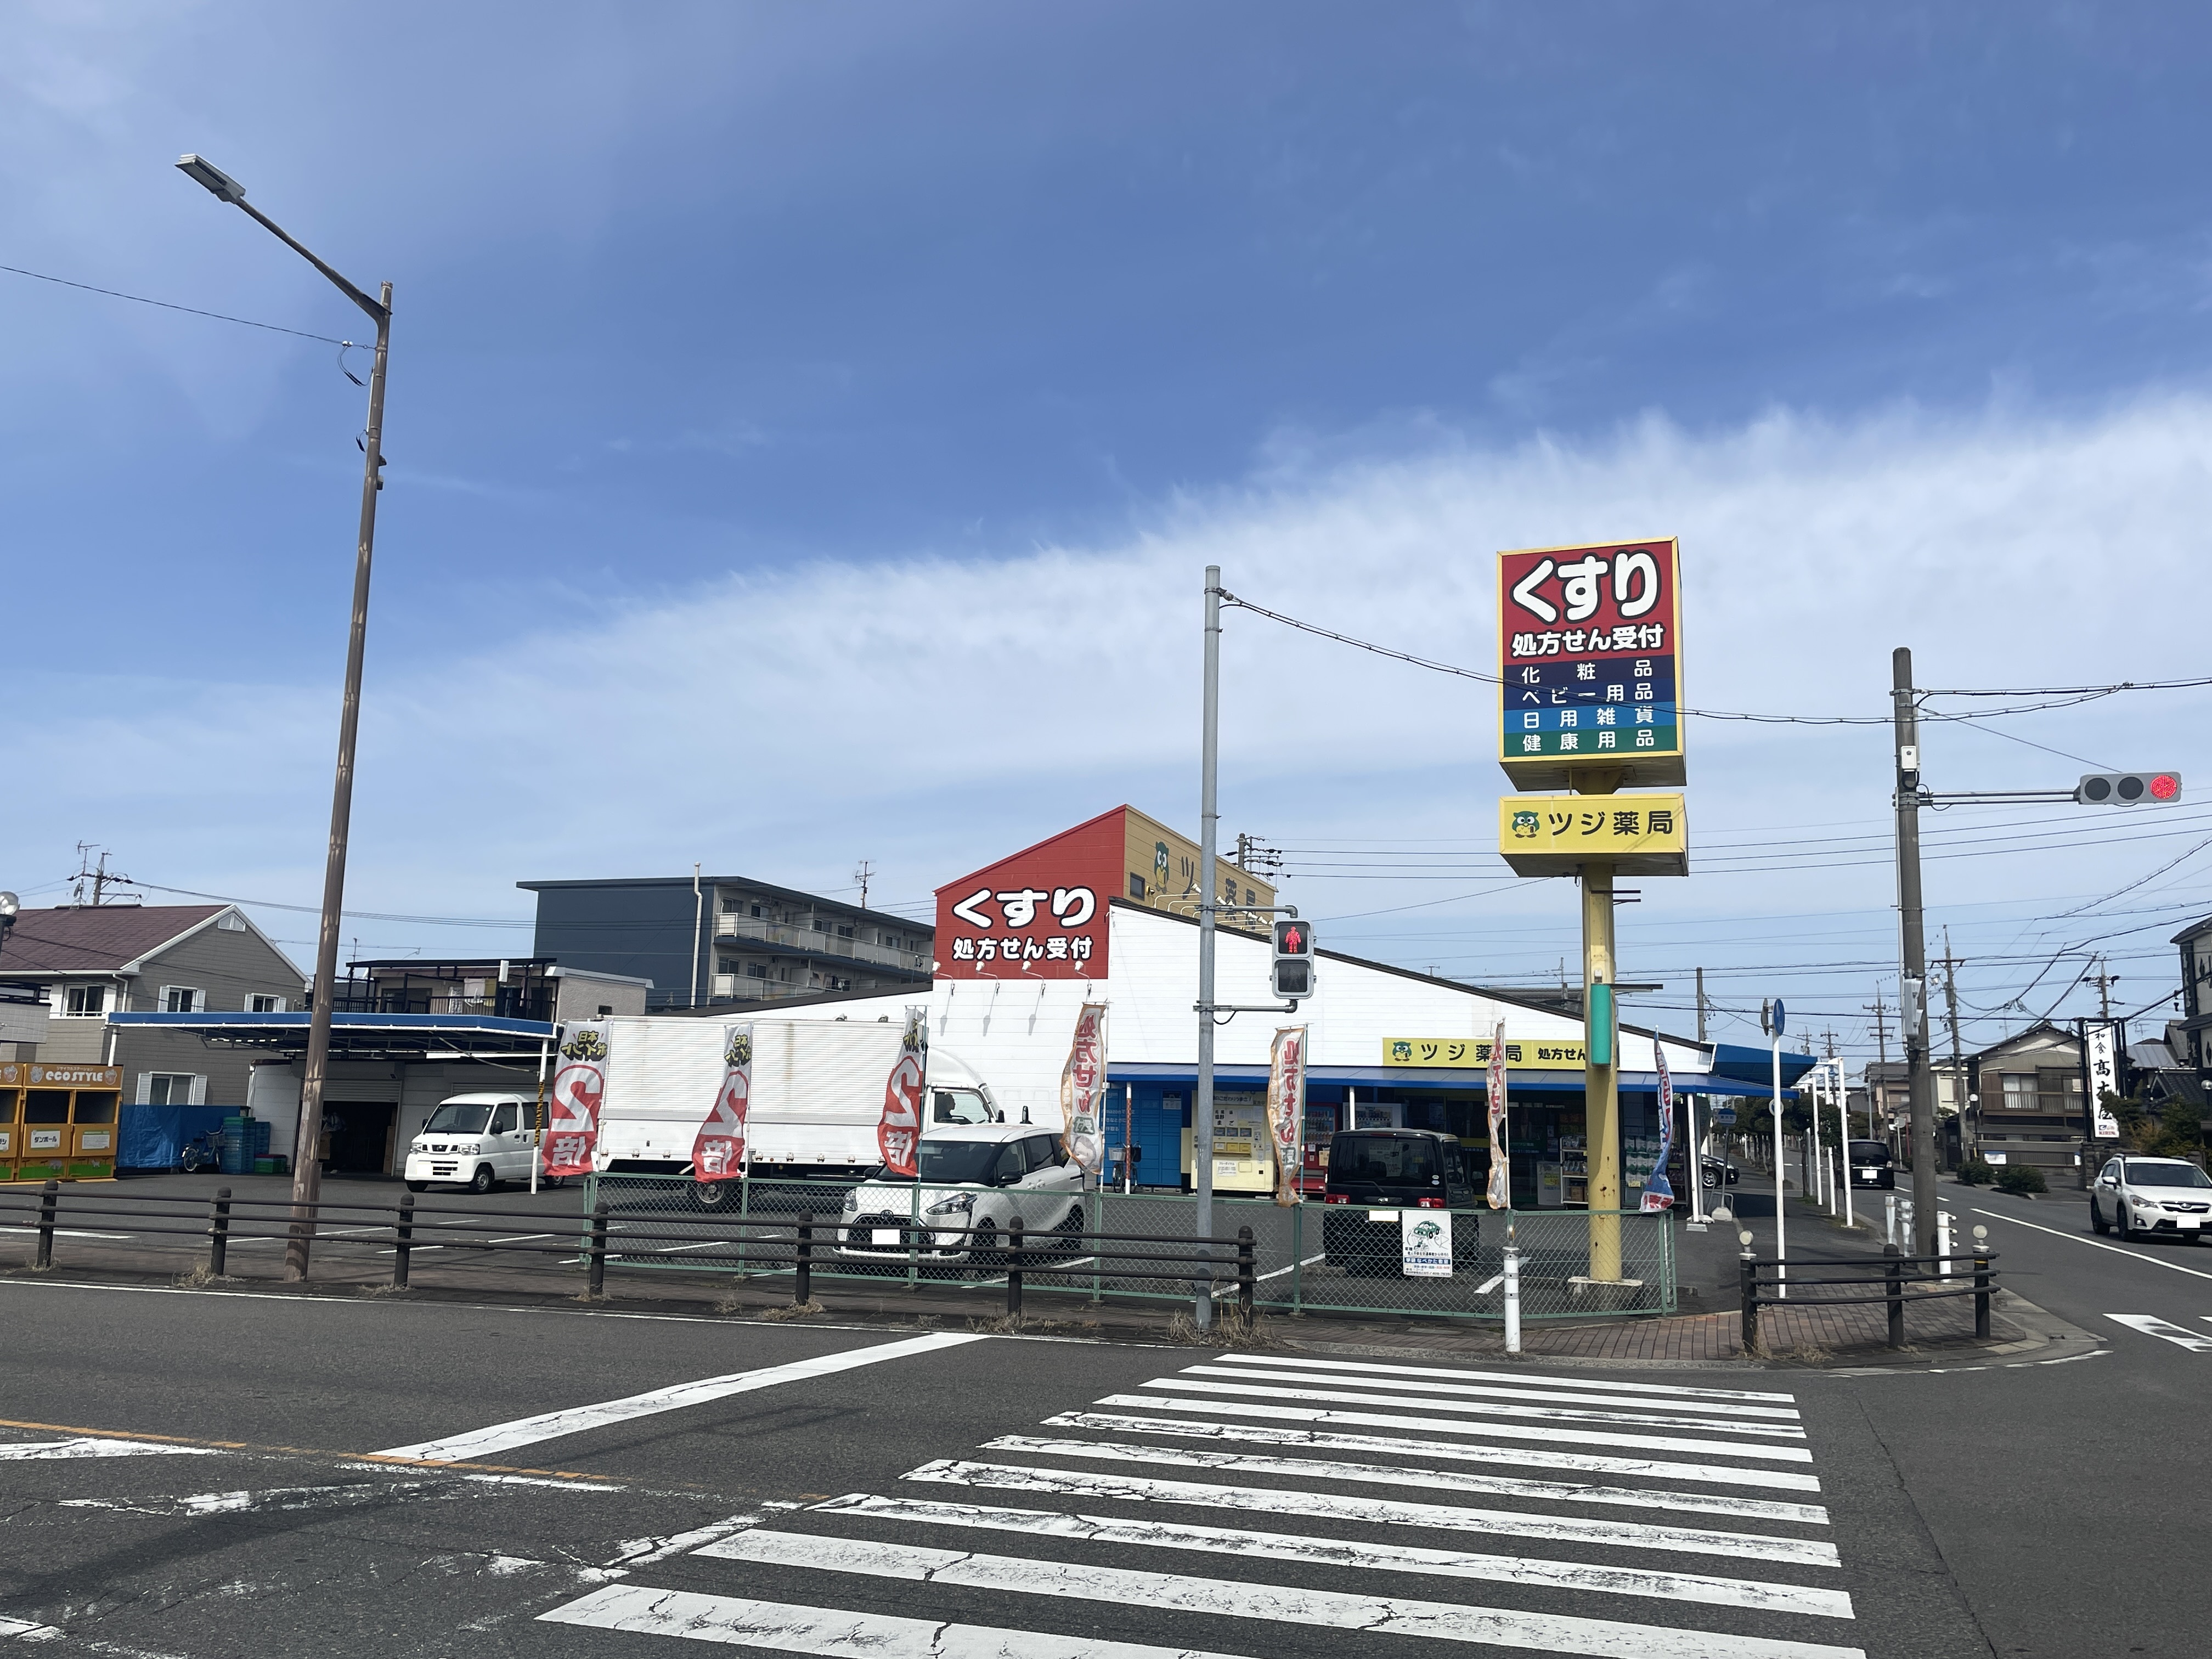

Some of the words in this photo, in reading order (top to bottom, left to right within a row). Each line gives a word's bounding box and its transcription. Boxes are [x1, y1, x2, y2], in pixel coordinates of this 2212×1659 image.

[1512, 551, 1659, 623] くすり
[1512, 624, 1663, 658] 処方せん受付
[1522, 659, 1652, 684] 化粧品
[1522, 682, 1652, 704] ベビー用品
[1523, 706, 1654, 729] 日用雑貨
[1523, 729, 1654, 752] 健康用品
[1548, 810, 1673, 836] ツジ薬局
[953, 888, 1096, 927] くすり
[953, 936, 1093, 960] 処方せん受付
[1421, 1044, 1522, 1062] ツジ薬局
[1538, 1048, 1585, 1060] 処方せん
